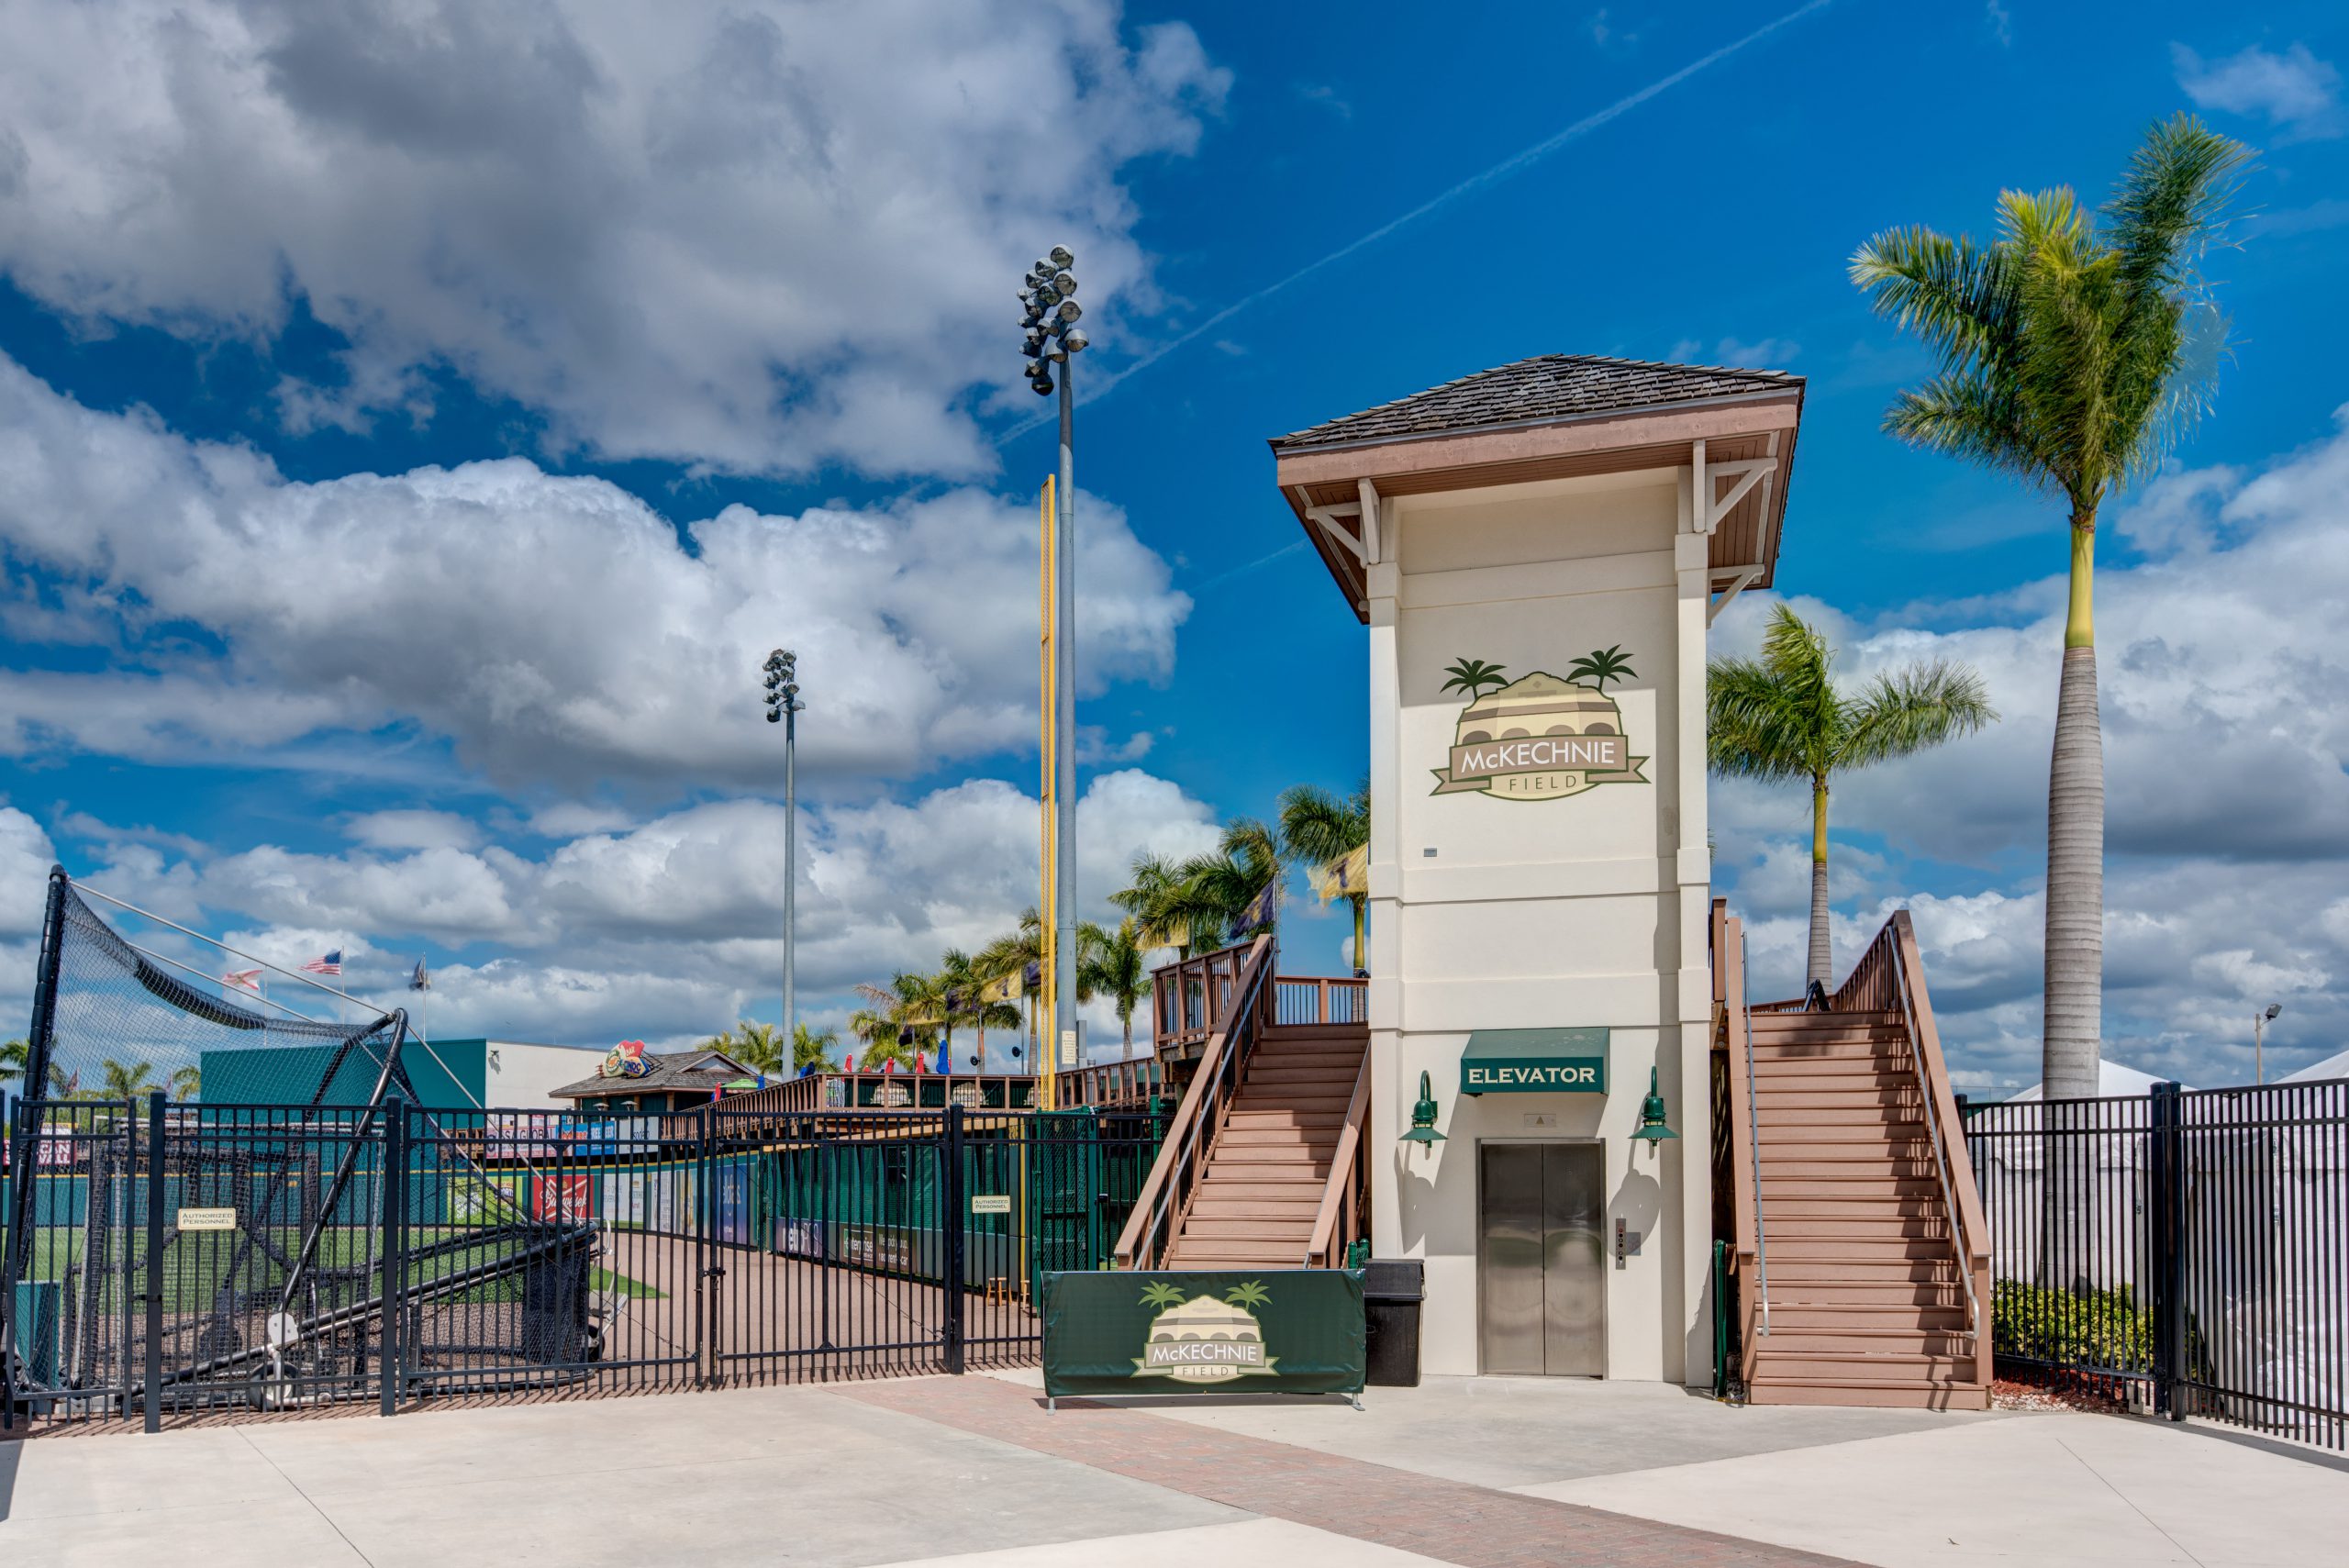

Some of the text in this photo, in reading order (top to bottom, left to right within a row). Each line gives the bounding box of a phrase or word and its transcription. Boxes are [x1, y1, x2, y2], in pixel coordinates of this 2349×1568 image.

[1461, 740, 1615, 773] McKECHNIE
[1508, 775, 1576, 791] FIELD
[1468, 1067, 1596, 1084] ELEVATOR
[782, 1222, 819, 1255] etroPCS
[1152, 1343, 1257, 1363] McKECHNIE
[1182, 1366, 1230, 1376] FIELD
